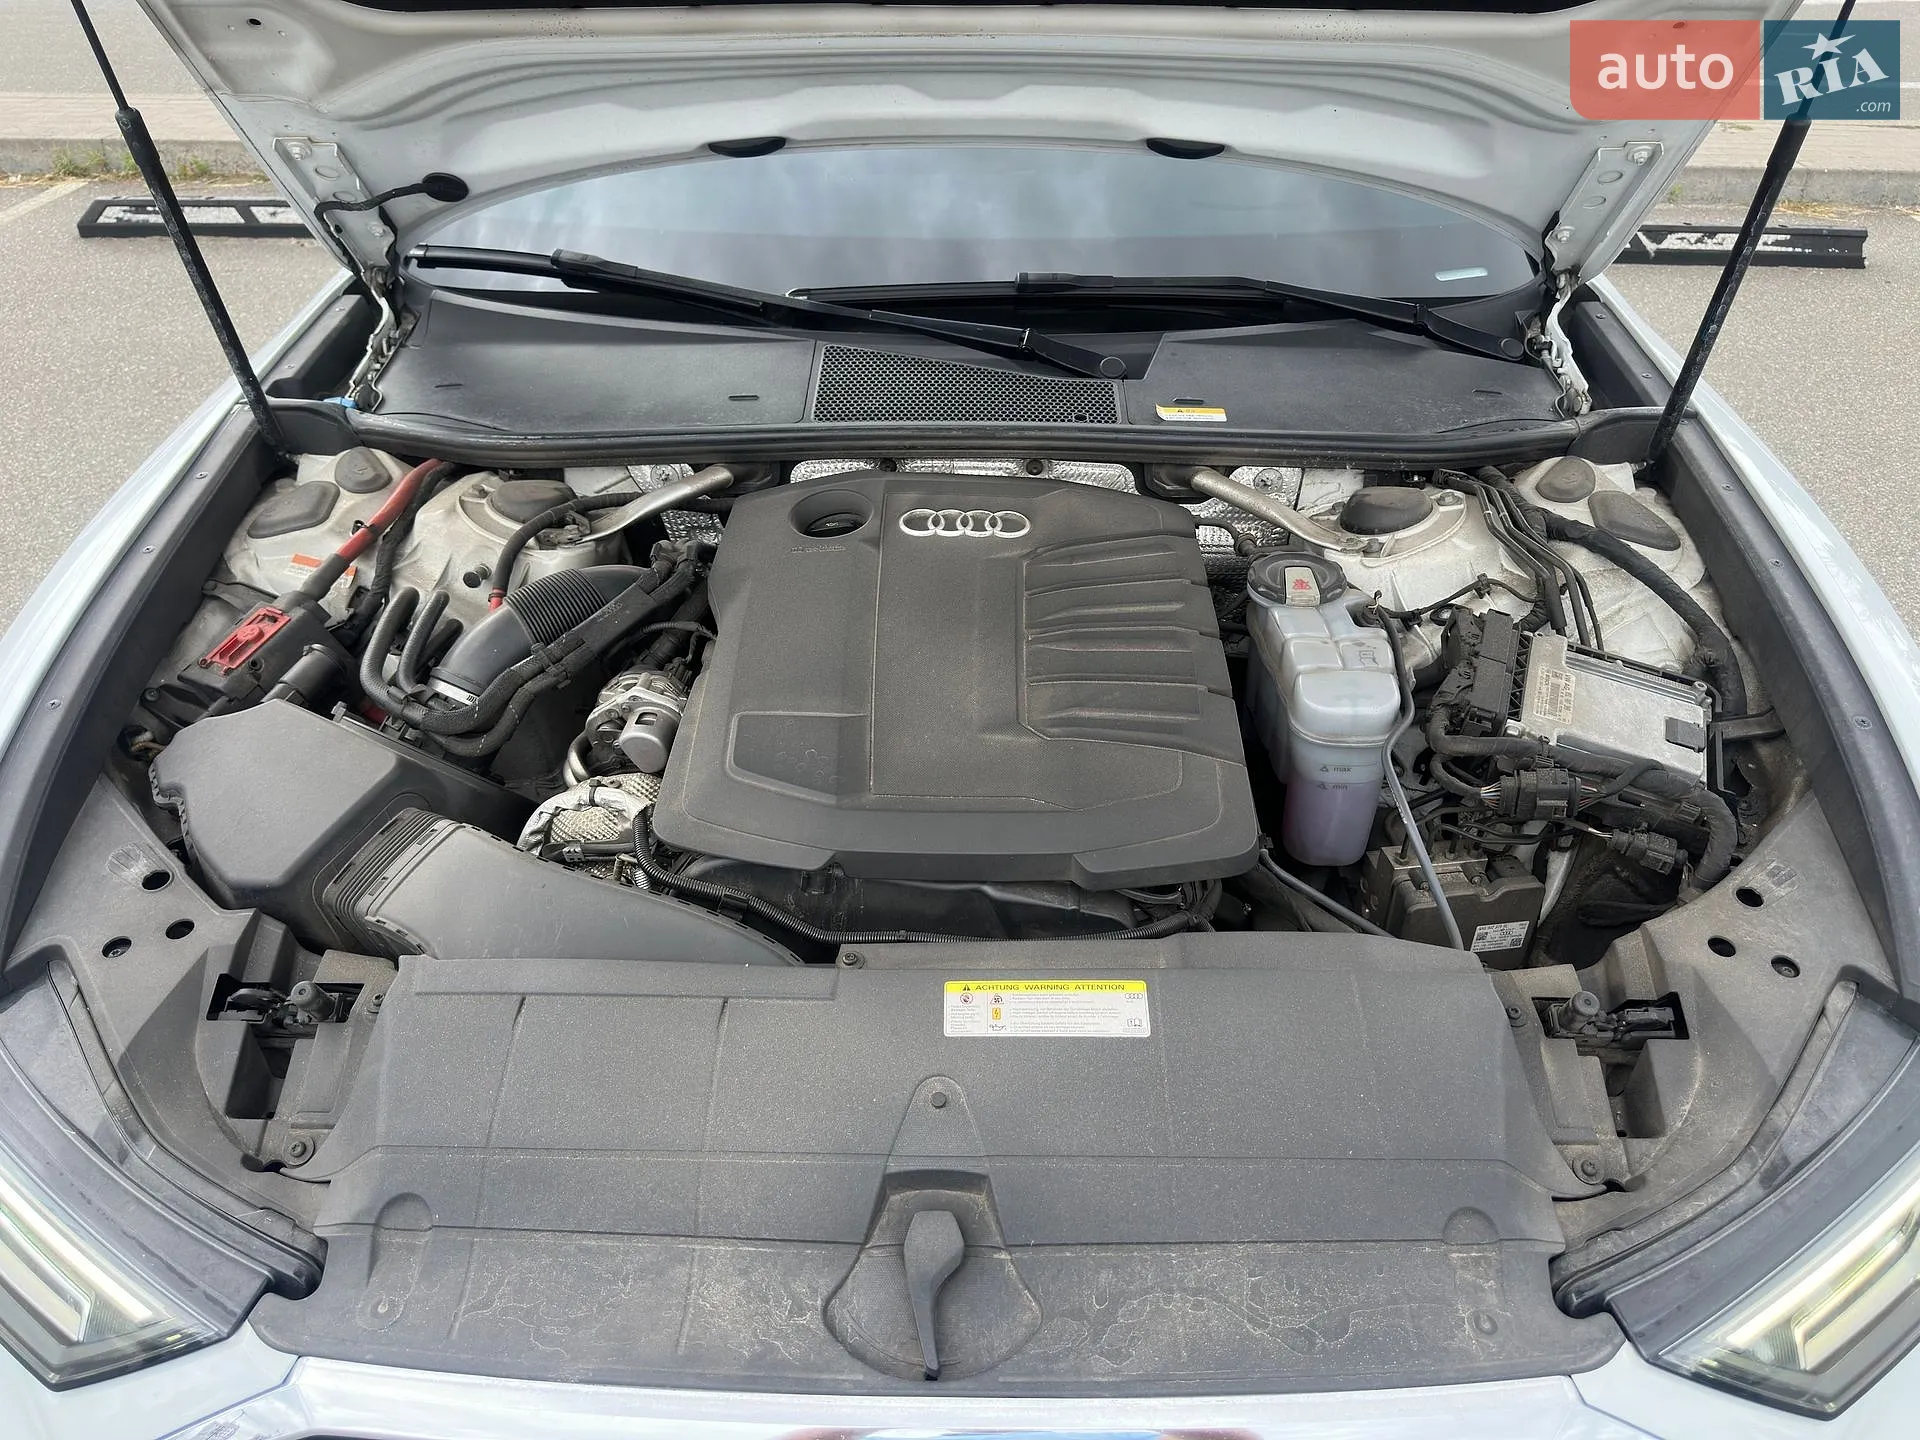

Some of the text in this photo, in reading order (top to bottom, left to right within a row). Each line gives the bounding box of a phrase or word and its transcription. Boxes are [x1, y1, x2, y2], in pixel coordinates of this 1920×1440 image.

[975, 983, 1125, 991] ACHTUNG WARNING ATTENTION
